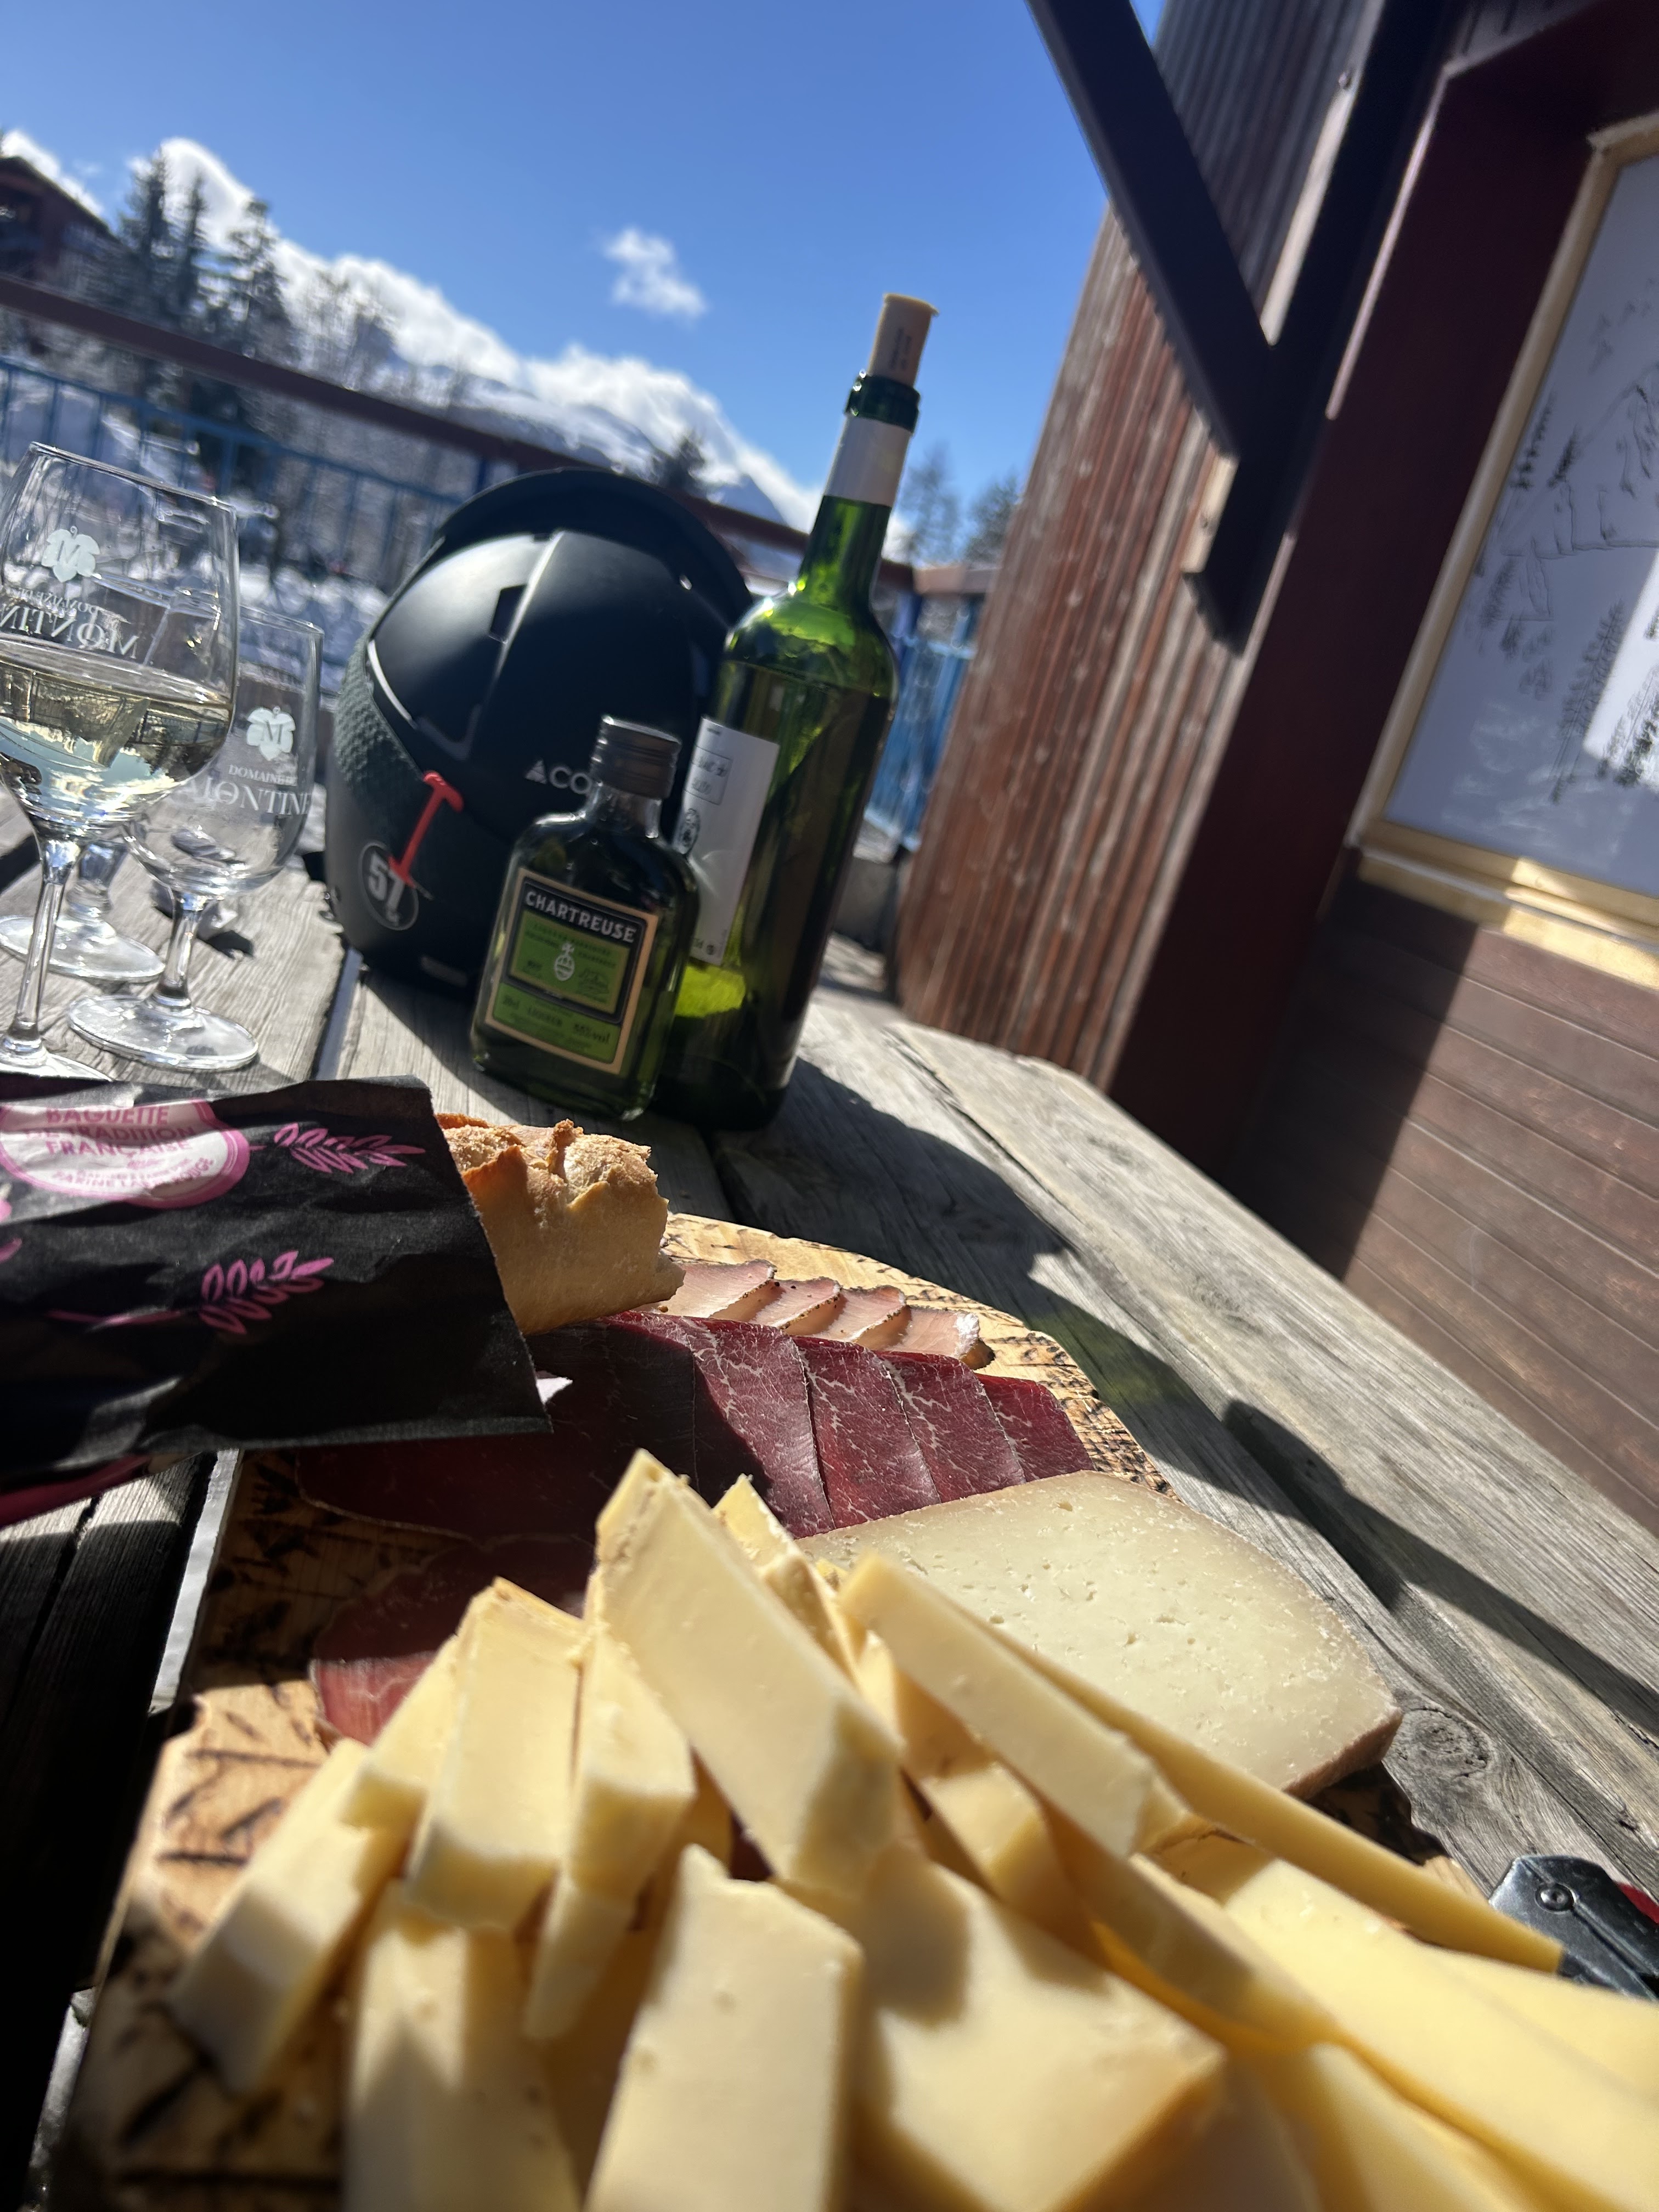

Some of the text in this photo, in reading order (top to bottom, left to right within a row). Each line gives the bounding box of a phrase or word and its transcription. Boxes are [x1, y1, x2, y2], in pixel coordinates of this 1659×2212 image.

[525, 891, 637, 943] CHARTREUSE
[46, 1106, 170, 1125] BAGUETTE
[67, 1124, 196, 1142] TRADITION
[46, 1137, 194, 1158] FRANÇAISE
